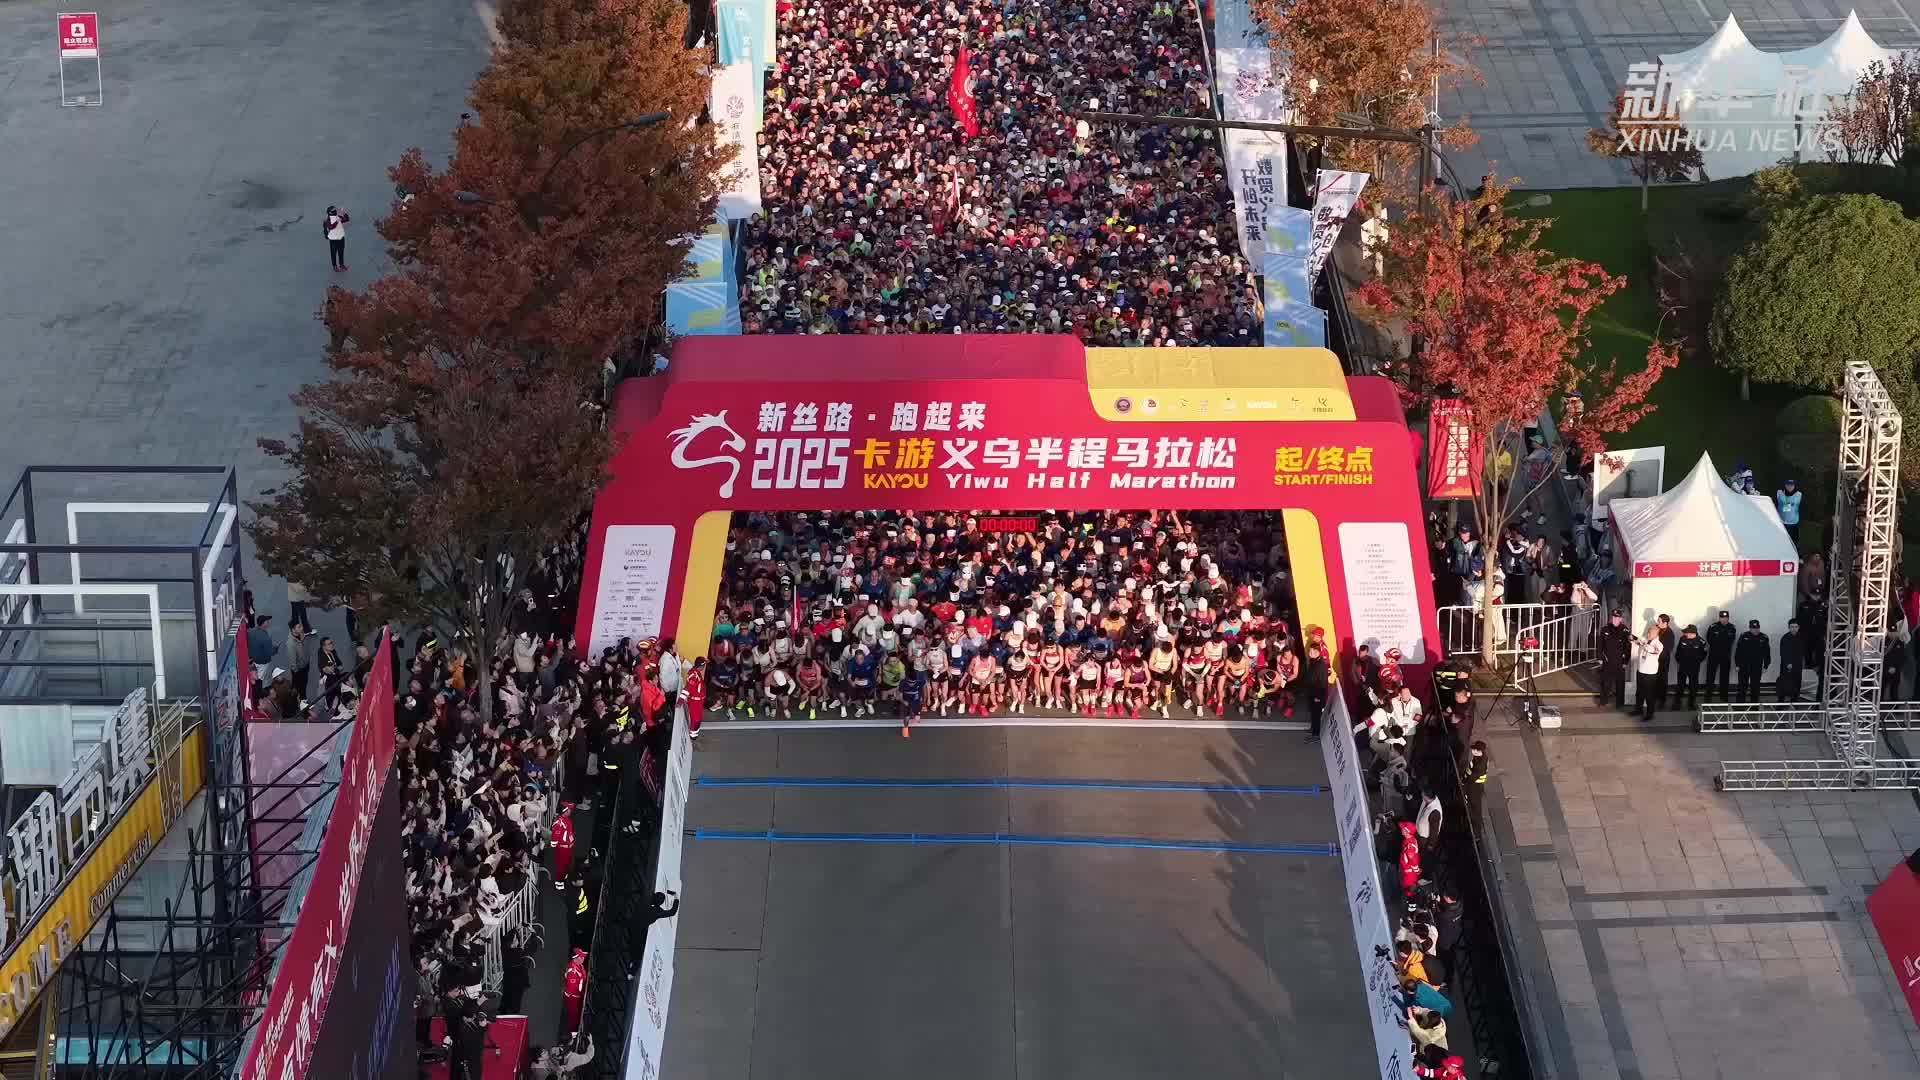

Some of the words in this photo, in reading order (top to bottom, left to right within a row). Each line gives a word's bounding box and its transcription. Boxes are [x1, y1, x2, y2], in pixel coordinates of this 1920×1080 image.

[1274, 446, 1374, 472] 起/终点
[864, 473, 928, 489] KAYOU
[945, 473, 1009, 489] Yiwu
[1027, 472, 1092, 489] Half
[1109, 473, 1237, 489] Marathon
[1274, 474, 1373, 486] START/FINISH
[980, 519, 1036, 531] 00:00:00
[1698, 561, 1733, 571] 计时点
